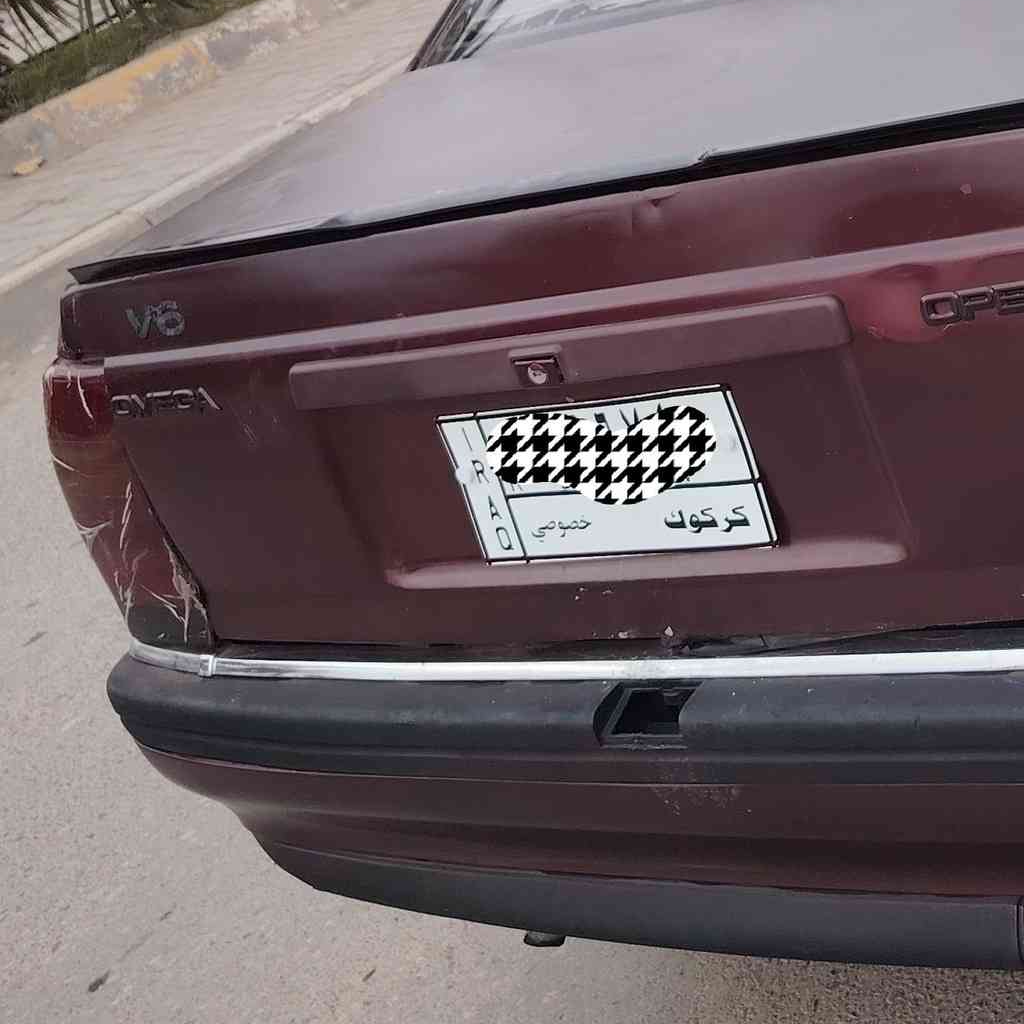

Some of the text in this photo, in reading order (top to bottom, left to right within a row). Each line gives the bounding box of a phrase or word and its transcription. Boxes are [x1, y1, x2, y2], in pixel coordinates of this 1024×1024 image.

[125, 300, 185, 338] V6
[530, 514, 593, 543] خصوصي
[663, 505, 751, 533] كركوك
